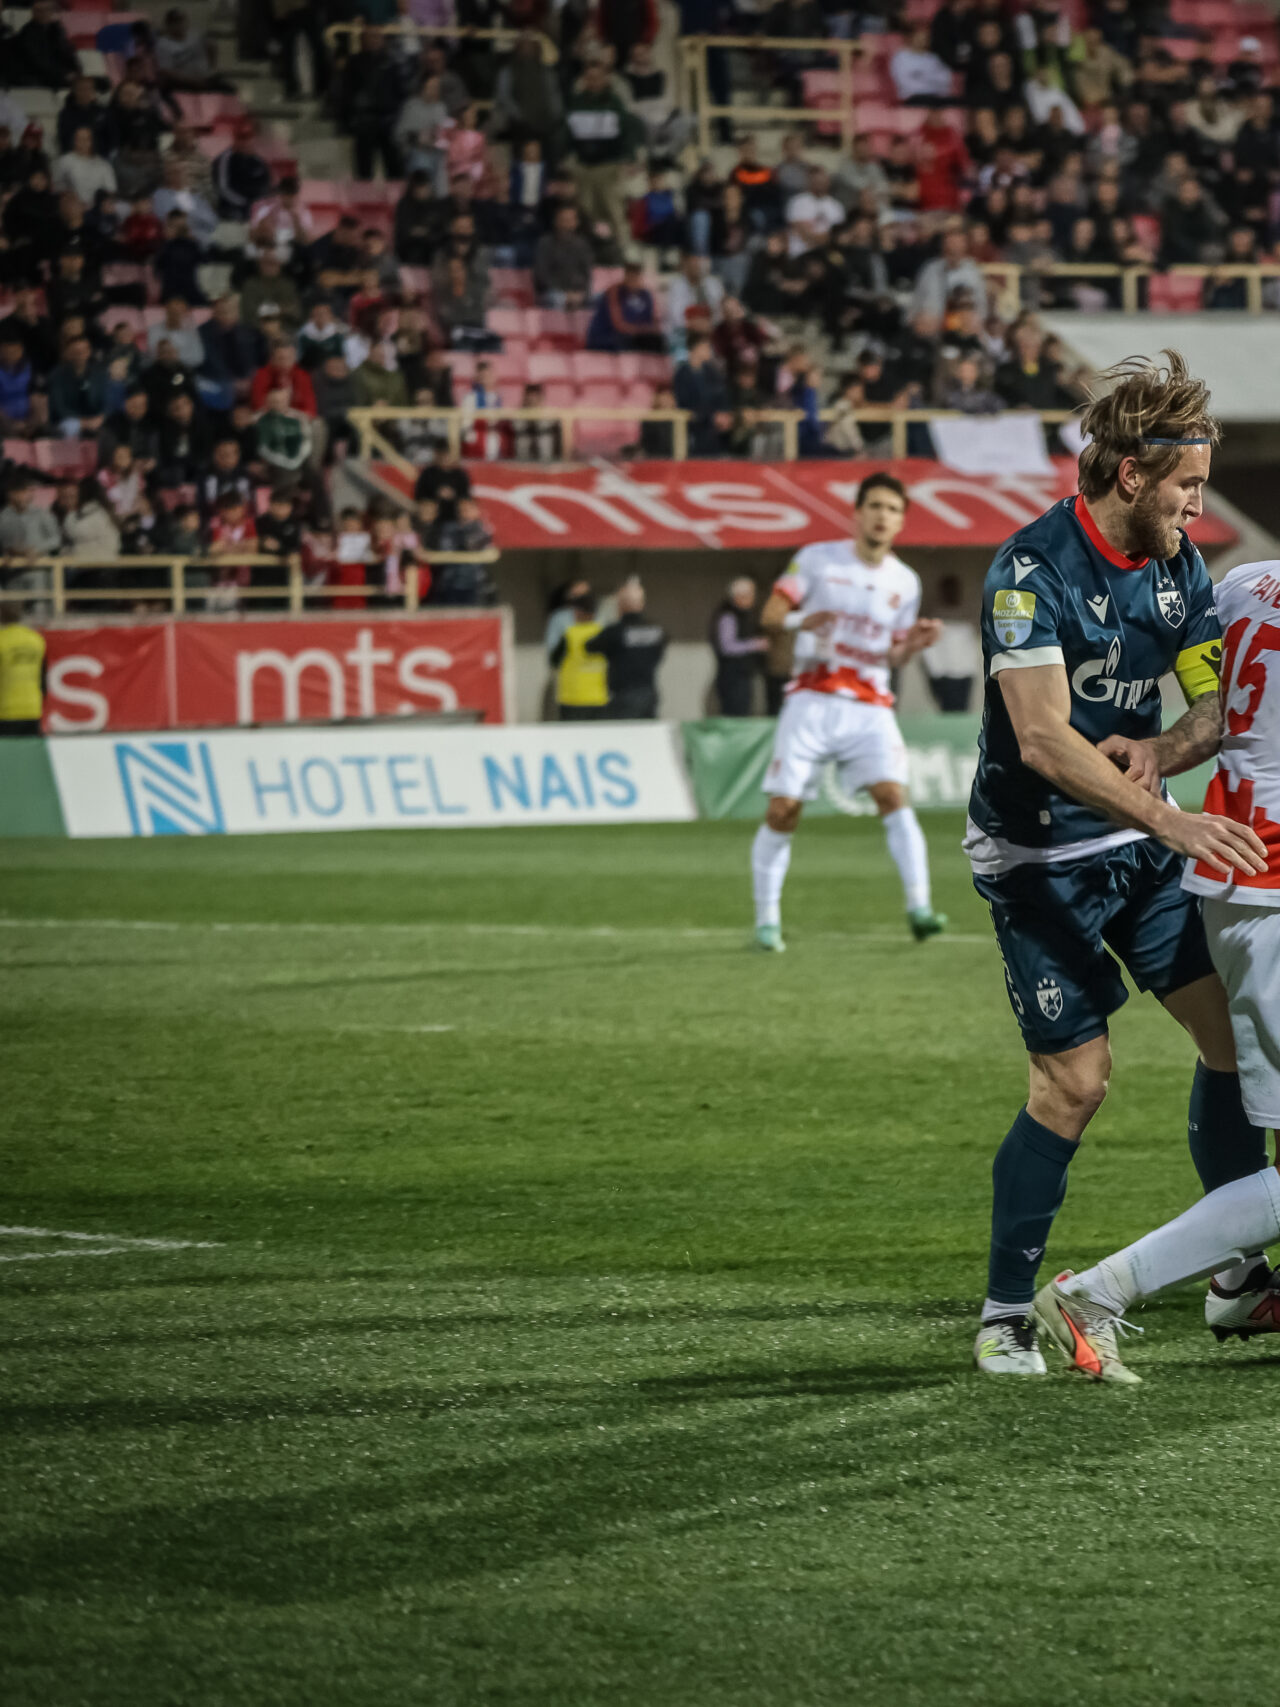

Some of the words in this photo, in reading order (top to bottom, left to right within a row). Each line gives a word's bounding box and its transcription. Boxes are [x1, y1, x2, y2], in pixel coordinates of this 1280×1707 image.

[236, 629, 459, 721] mts
[247, 753, 469, 817] HOTEL
[483, 749, 640, 812] NAIS
